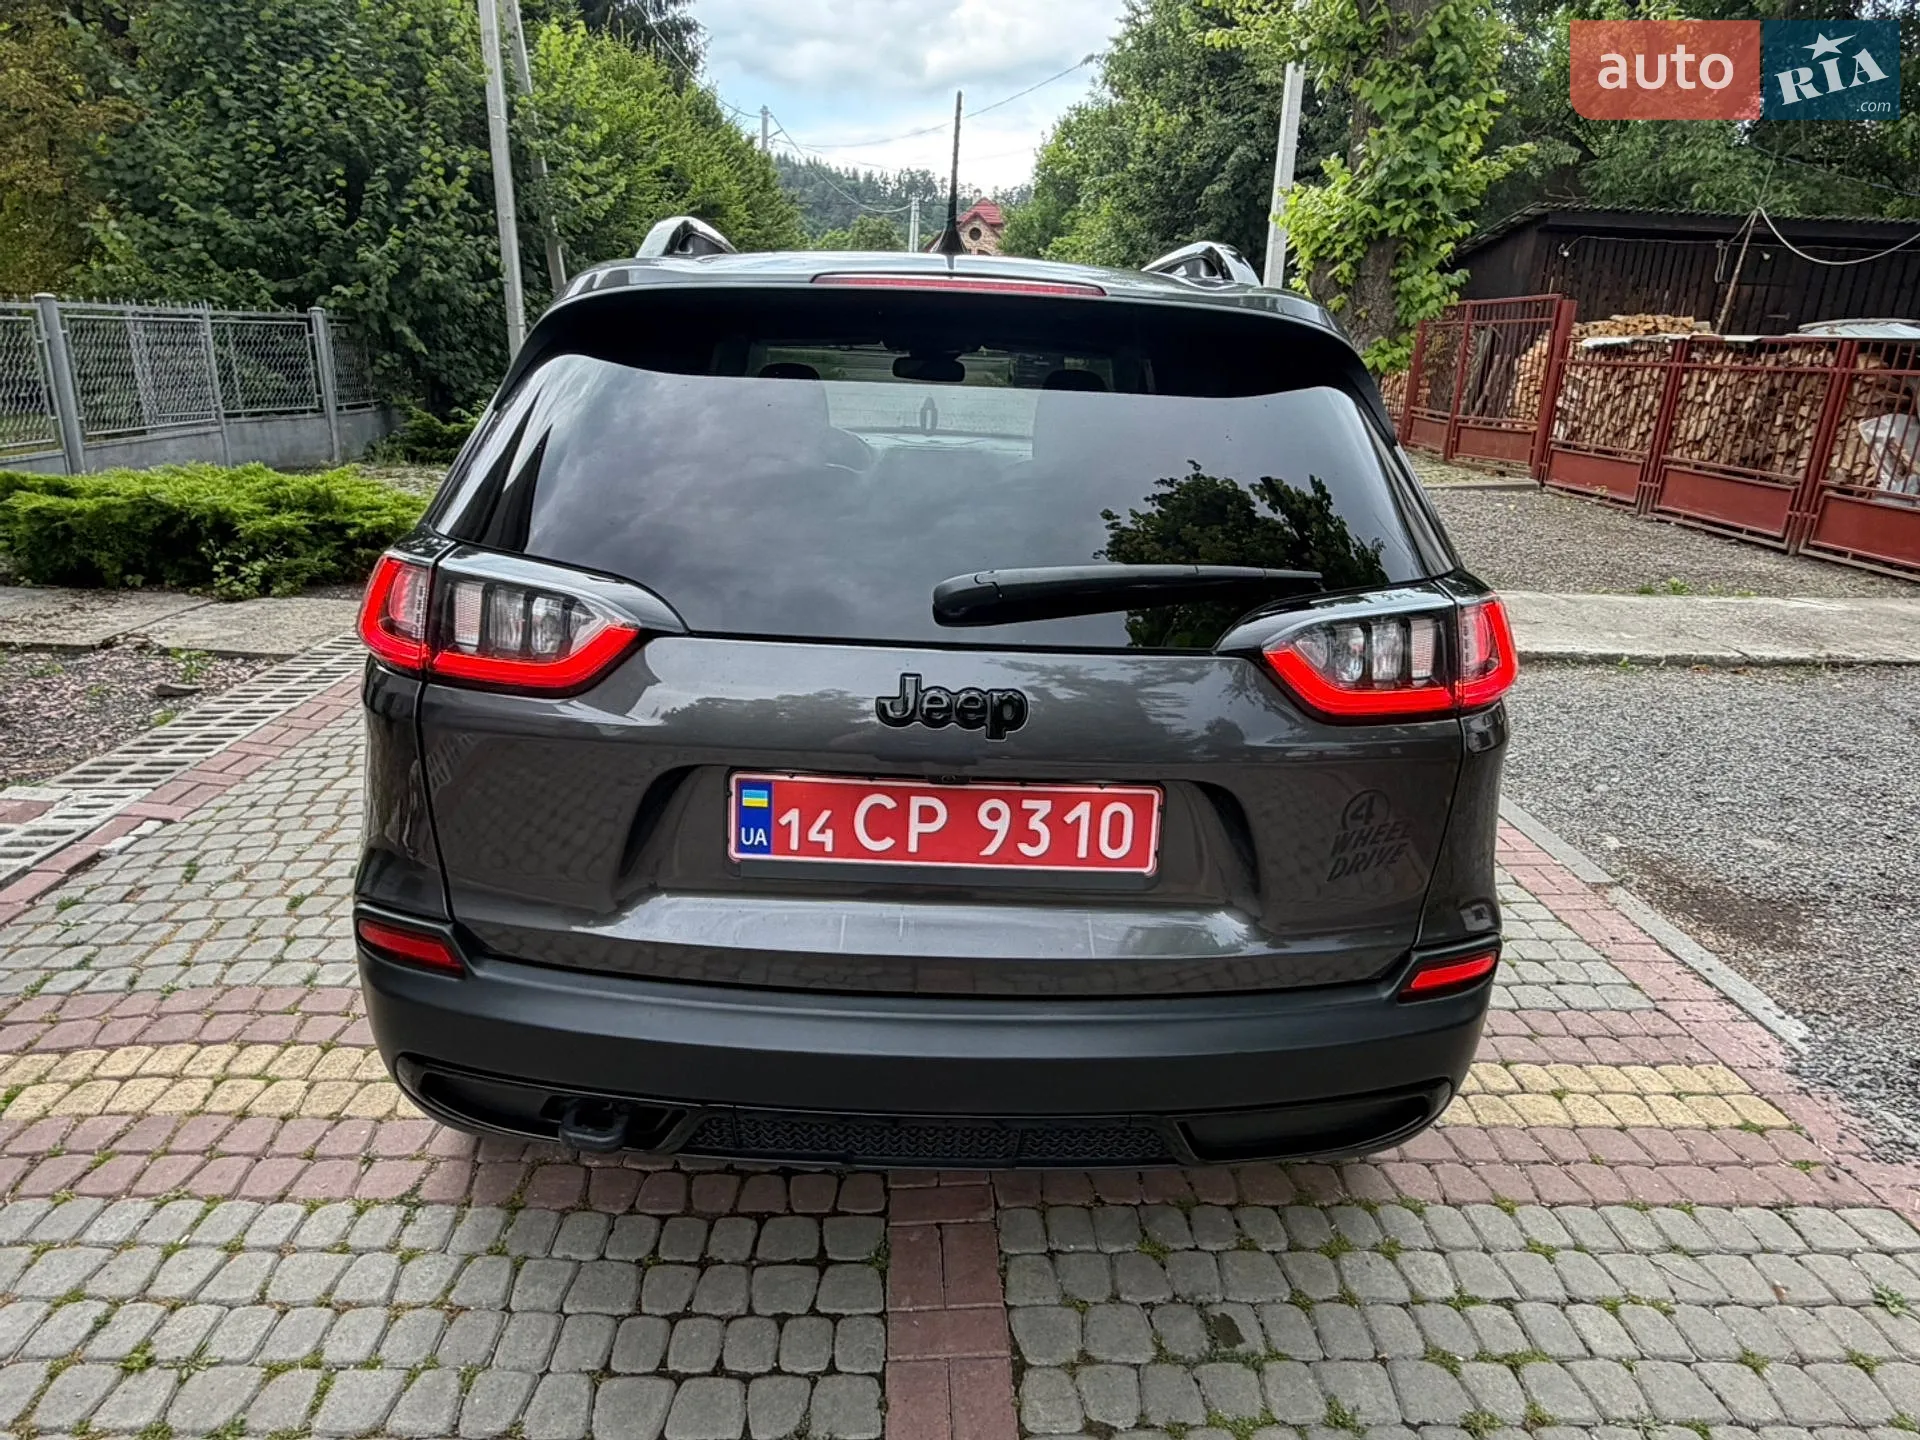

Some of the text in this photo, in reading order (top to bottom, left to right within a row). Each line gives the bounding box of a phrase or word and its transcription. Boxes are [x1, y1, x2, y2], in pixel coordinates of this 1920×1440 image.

[875, 673, 1029, 741] Jeep
[779, 793, 1134, 859] 14 CP 9310
[1350, 795, 1375, 825] 4
[741, 826, 768, 847] UA
[1331, 820, 1410, 859] WHEEL
[1326, 843, 1408, 882] DRIVE
